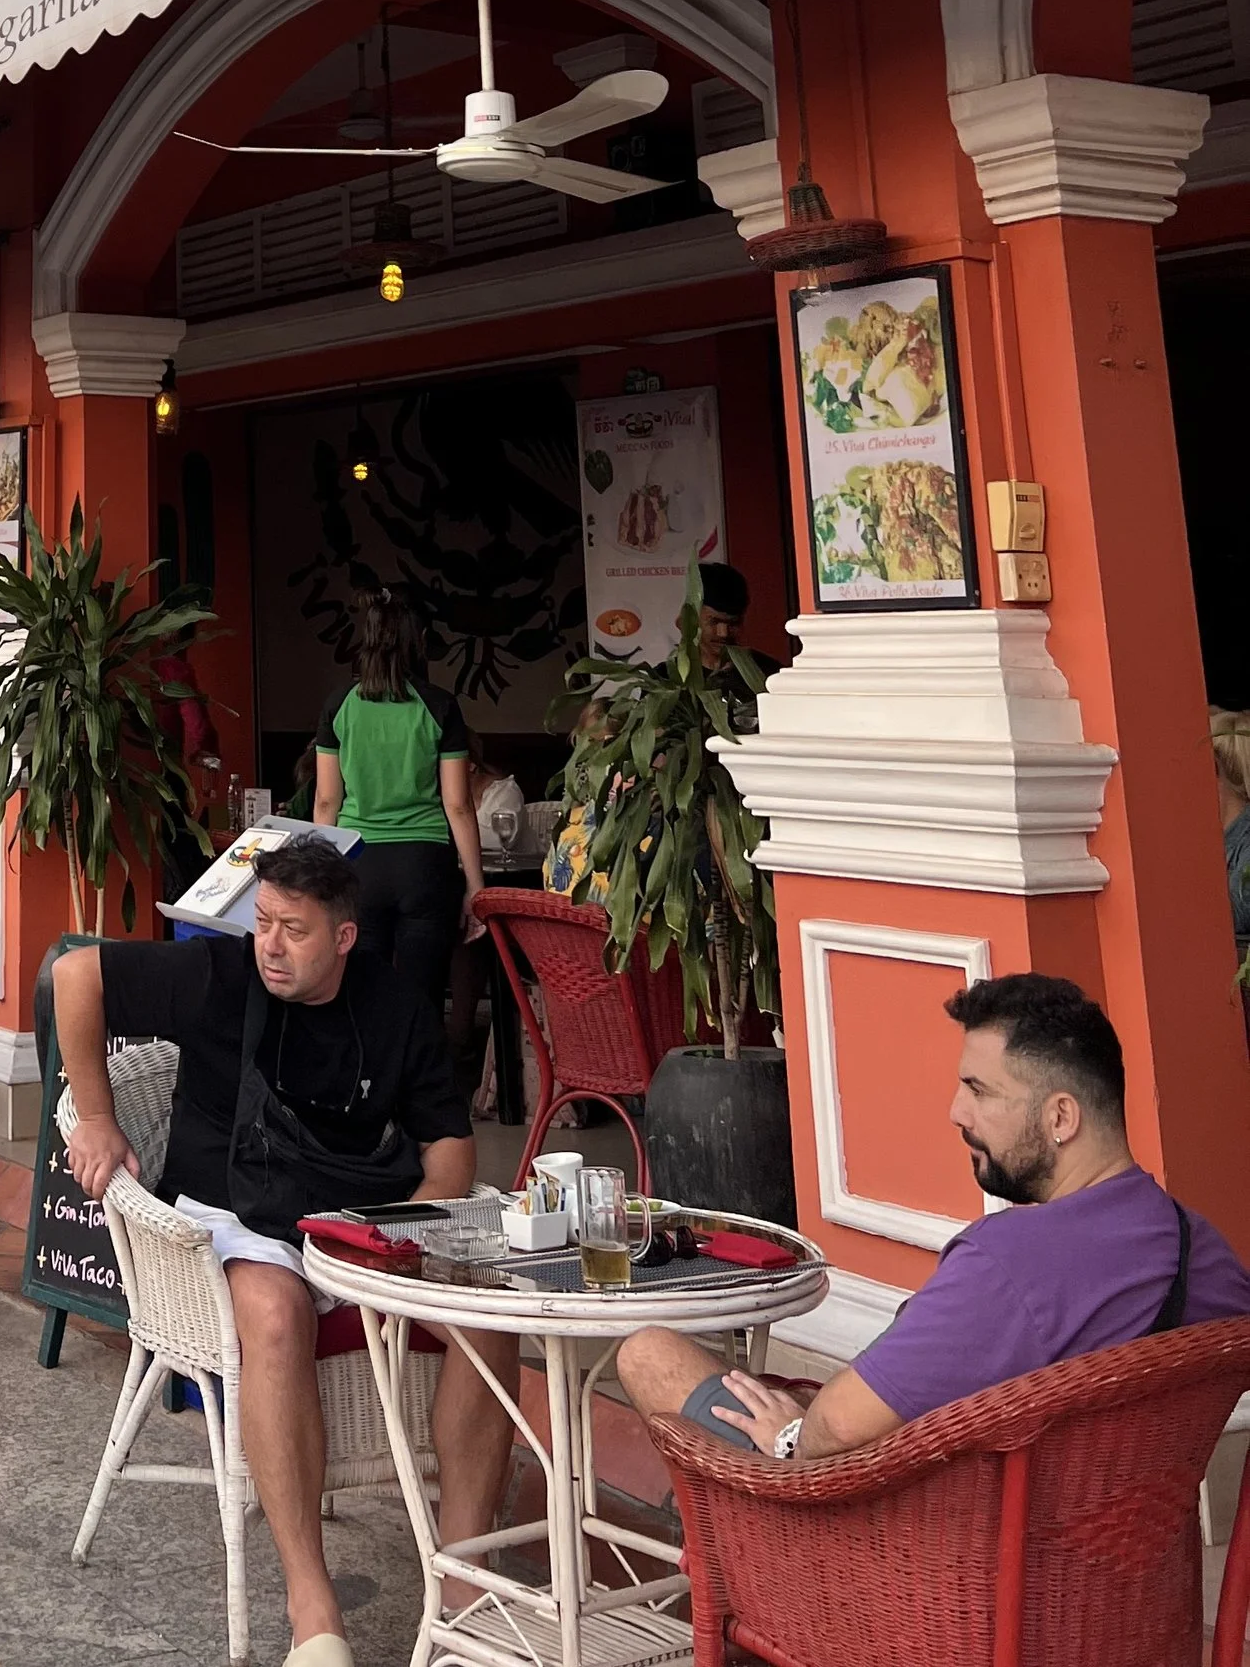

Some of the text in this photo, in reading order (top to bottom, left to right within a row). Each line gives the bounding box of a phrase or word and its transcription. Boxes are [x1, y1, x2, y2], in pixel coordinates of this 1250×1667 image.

[606, 566, 637, 577] GRILLED
[637, 566, 671, 576] CHICKEN
[54, 1196, 77, 1222] Gin
[79, 1255, 116, 1290] Taco
